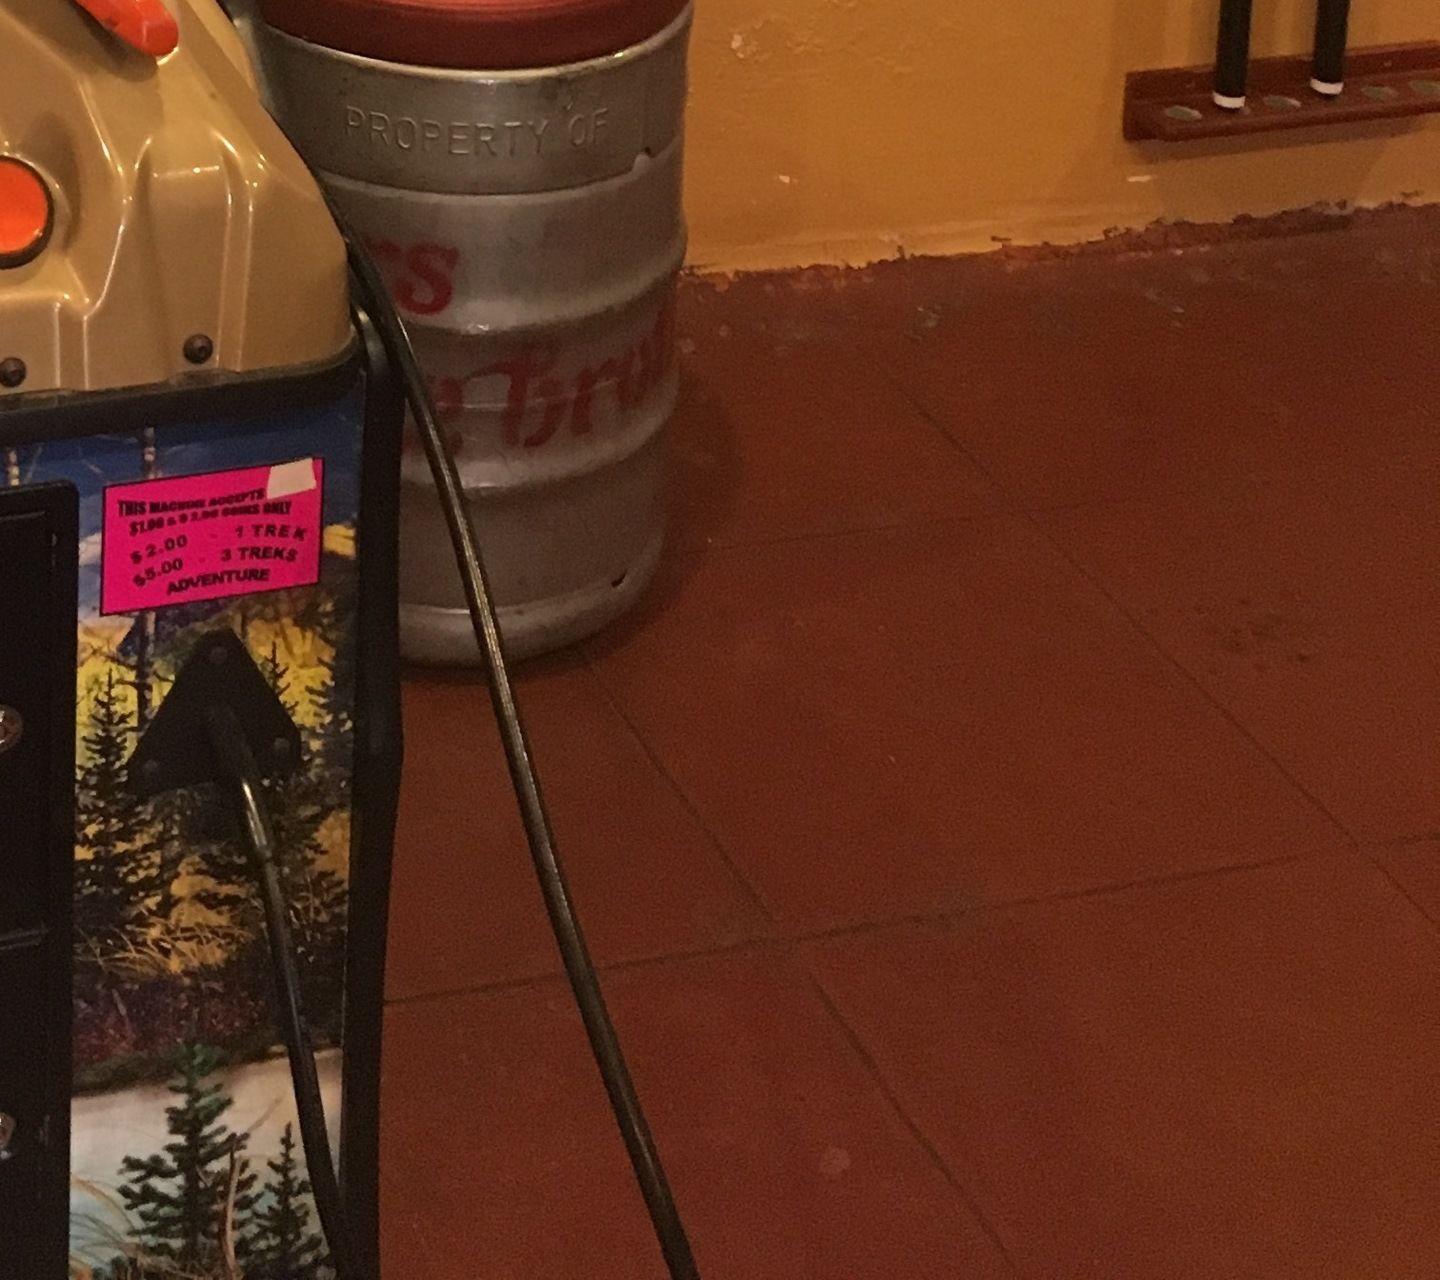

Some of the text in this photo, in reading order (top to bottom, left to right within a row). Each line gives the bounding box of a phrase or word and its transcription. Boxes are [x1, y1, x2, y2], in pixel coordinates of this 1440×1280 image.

[344, 105, 609, 158] PROPERTY OF
[118, 499, 147, 517] THIS
[149, 499, 206, 514] MACHINE
[263, 501, 292, 515] ONLY
[251, 523, 307, 542] TREK
[237, 546, 298, 562] TREKS
[166, 567, 271, 595] ADVENTURE
